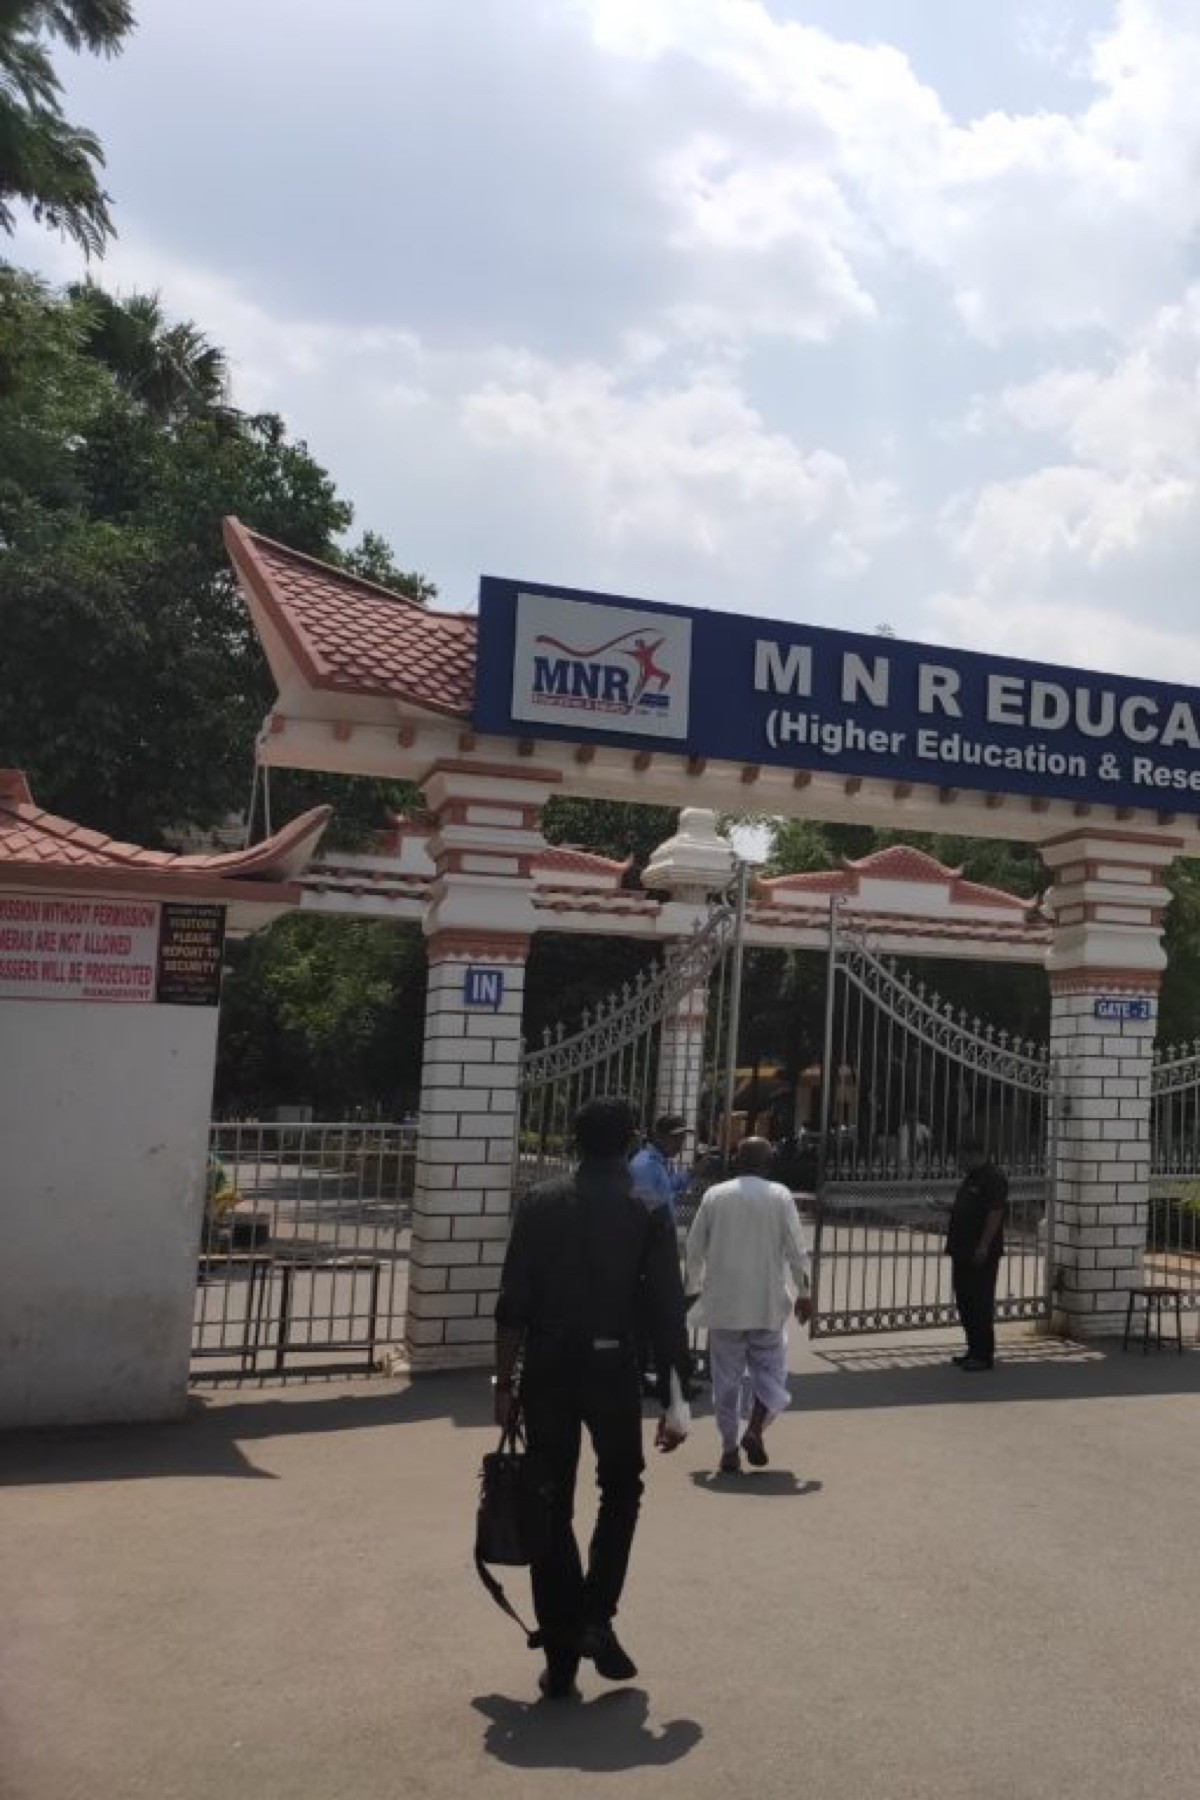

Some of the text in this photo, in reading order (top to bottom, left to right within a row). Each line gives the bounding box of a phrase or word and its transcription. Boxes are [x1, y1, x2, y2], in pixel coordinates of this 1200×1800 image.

[532, 655, 631, 703] MNR
[754, 638, 812, 697] M
[841, 652, 889, 706] N
[918, 664, 963, 717] R
[766, 710, 906, 756] (Higher
[916, 729, 1086, 777] Education
[1099, 754, 1121, 781] &
[42, 901, 90, 924] WITHOUT
[93, 904, 154, 926] PERMISSION
[35, 930, 56, 952] ARE
[59, 932, 81, 953] NOT
[84, 933, 131, 955] ALLOWED
[172, 932, 212, 943] PLEASE
[162, 946, 221, 959] REPORT TO
[42, 961, 65, 982] WILL
[69, 961, 83, 983] BE
[86, 963, 151, 985] PROSECUTED
[164, 960, 216, 973] SECURITY
[473, 974, 498, 1002] IN
[1098, 1002, 1130, 1017] GATE
